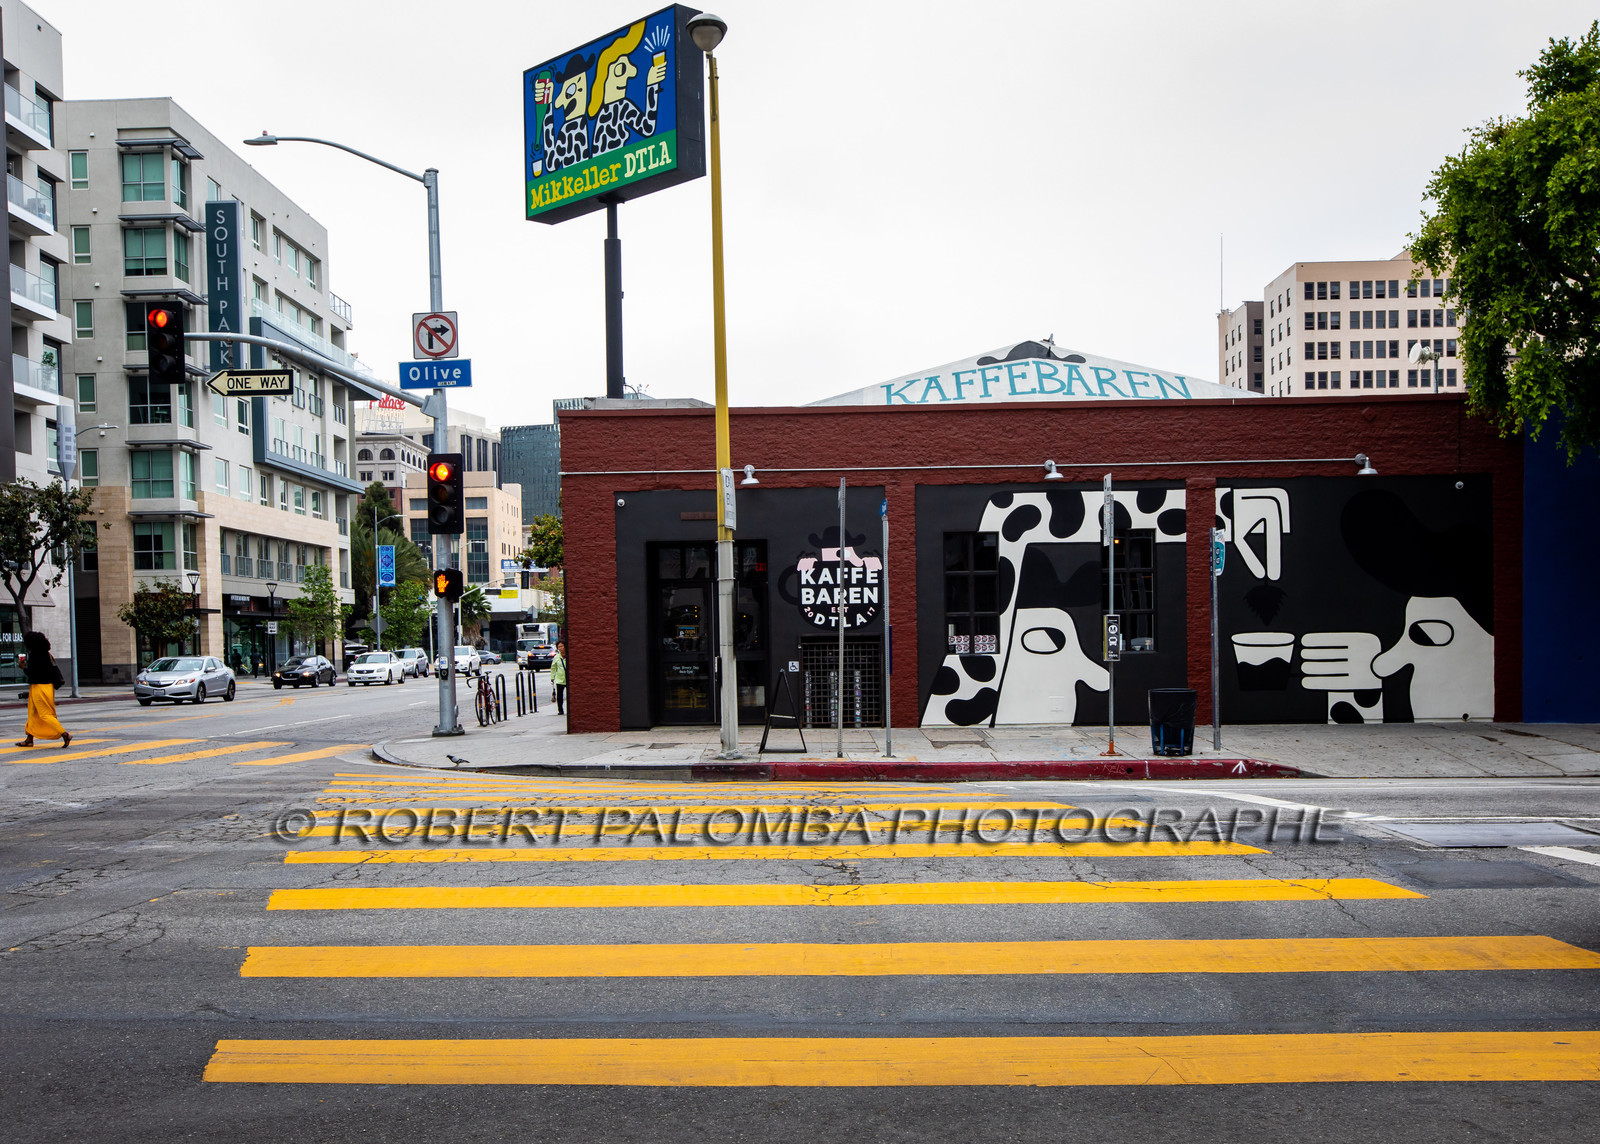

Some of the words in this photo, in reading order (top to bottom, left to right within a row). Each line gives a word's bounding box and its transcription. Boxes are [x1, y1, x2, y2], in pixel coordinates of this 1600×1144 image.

[531, 163, 621, 209] Mikkeller
[624, 140, 672, 178] DTLA
[214, 210, 229, 291] SOUTH
[409, 366, 462, 381] Olive
[227, 377, 251, 390] ONE
[260, 376, 286, 389] WAY
[880, 361, 1193, 404] KAFFEBAREN
[801, 567, 879, 585] KAFFE
[801, 587, 879, 605] BAREN
[804, 606, 814, 618] 20
[866, 606, 876, 617] 17
[813, 613, 868, 628] DTLA
